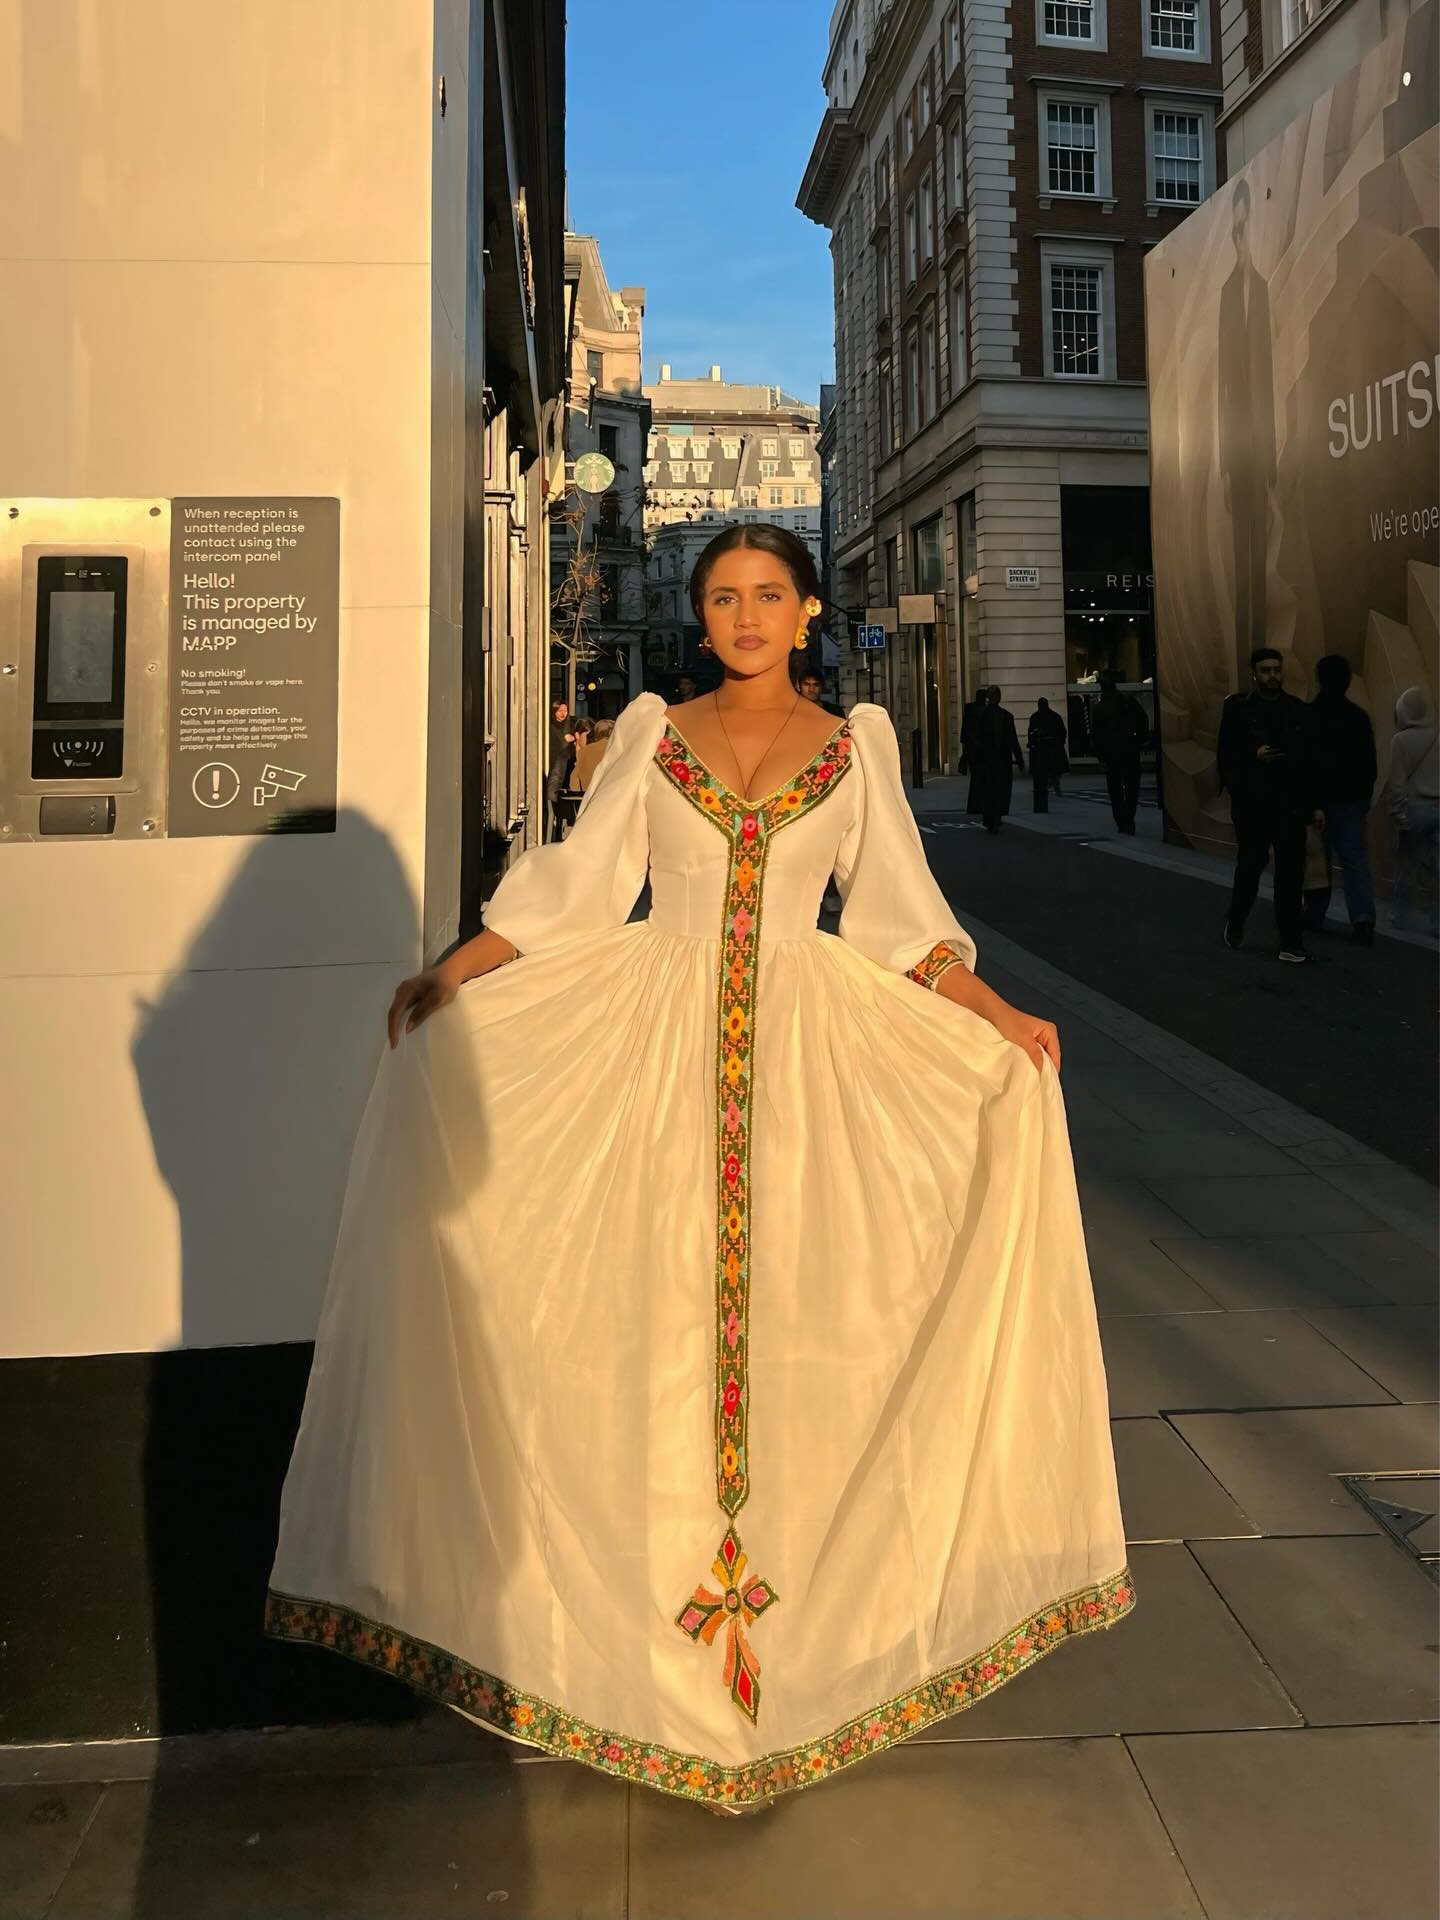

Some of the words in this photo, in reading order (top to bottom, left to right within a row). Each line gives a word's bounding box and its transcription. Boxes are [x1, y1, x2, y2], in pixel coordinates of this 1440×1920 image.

[1328, 354, 1440, 459] SUITS
[184, 508, 220, 519] When
[223, 508, 286, 520] reception
[288, 508, 299, 519] is
[184, 522, 259, 533] unattended
[262, 522, 305, 535] please
[1369, 509, 1408, 542] We're
[183, 538, 236, 548] contact
[239, 537, 273, 550] using
[276, 537, 297, 547] the
[183, 551, 242, 562] intercom
[245, 551, 281, 564] panel
[183, 573, 235, 589] Hello!
[182, 594, 220, 609] This
[224, 594, 306, 613] property
[182, 615, 197, 631] is
[202, 613, 290, 634] managed
[295, 613, 318, 633] by
[182, 636, 237, 651] MAPP
[181, 669, 196, 678] No
[199, 668, 246, 679] smoking!
[180, 707, 212, 717] CCTV
[213, 706, 223, 716] in
[225, 706, 280, 717] operation.
[290, 725, 307, 733] your
[180, 735, 205, 743] safety
